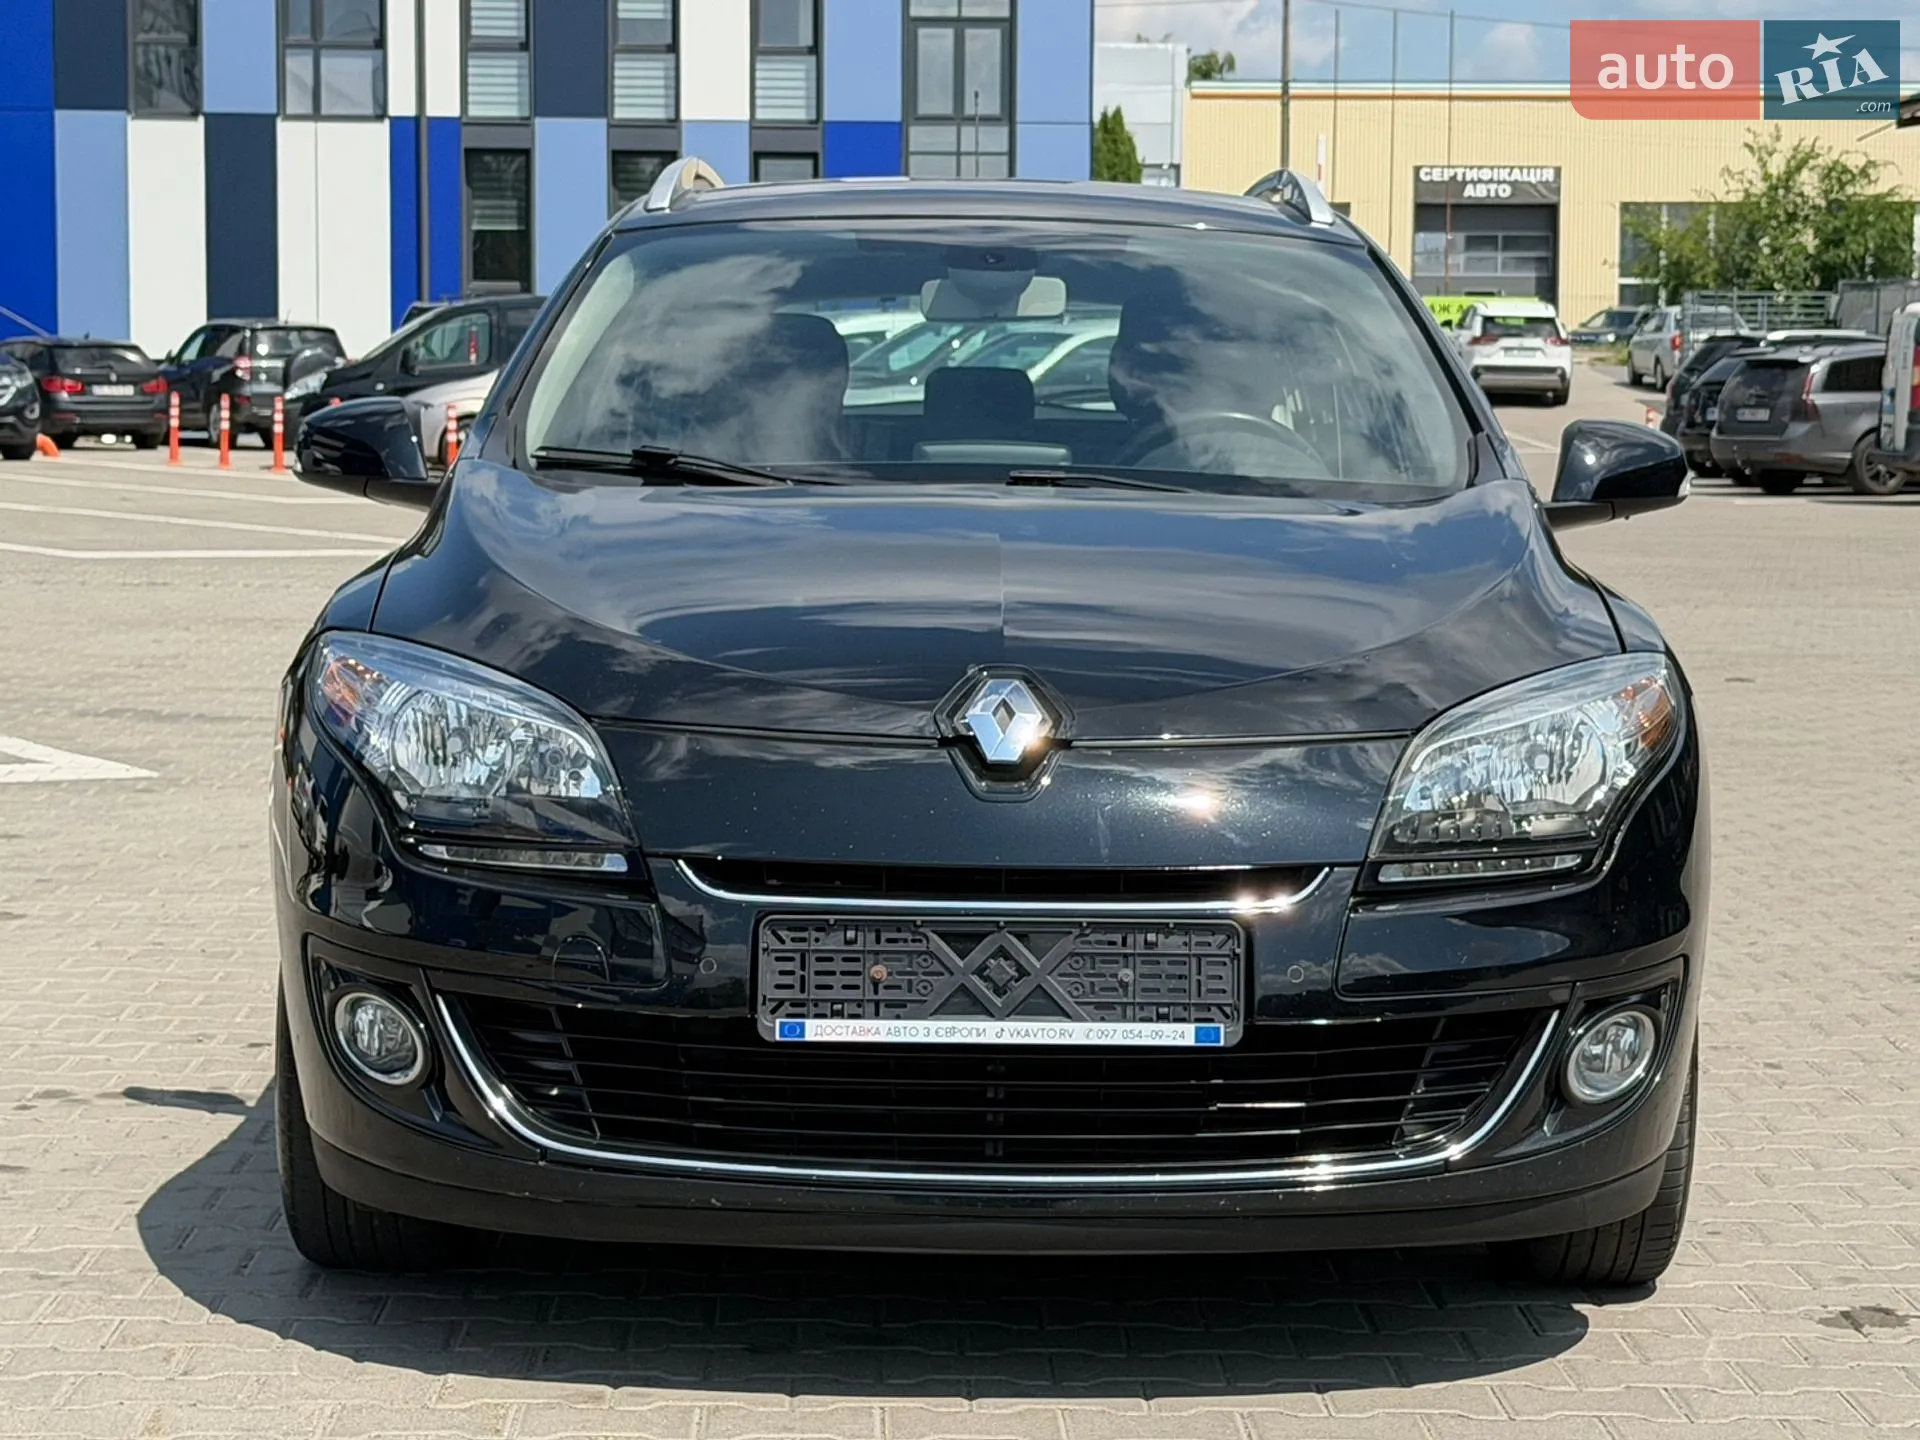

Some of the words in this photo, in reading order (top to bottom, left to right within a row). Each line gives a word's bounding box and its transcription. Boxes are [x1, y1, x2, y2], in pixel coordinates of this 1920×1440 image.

[1419, 167, 1555, 184] СЕРТИФІКАЦІЯ
[1463, 183, 1512, 198] АВТО
[814, 1024, 881, 1037] ДОСТАВКА
[886, 1026, 920, 1037] АВТО
[936, 1027, 987, 1038] ЄВРОПИ
[1096, 1028, 1117, 1040] 097
[1121, 1029, 1186, 1041] 054-09-24
